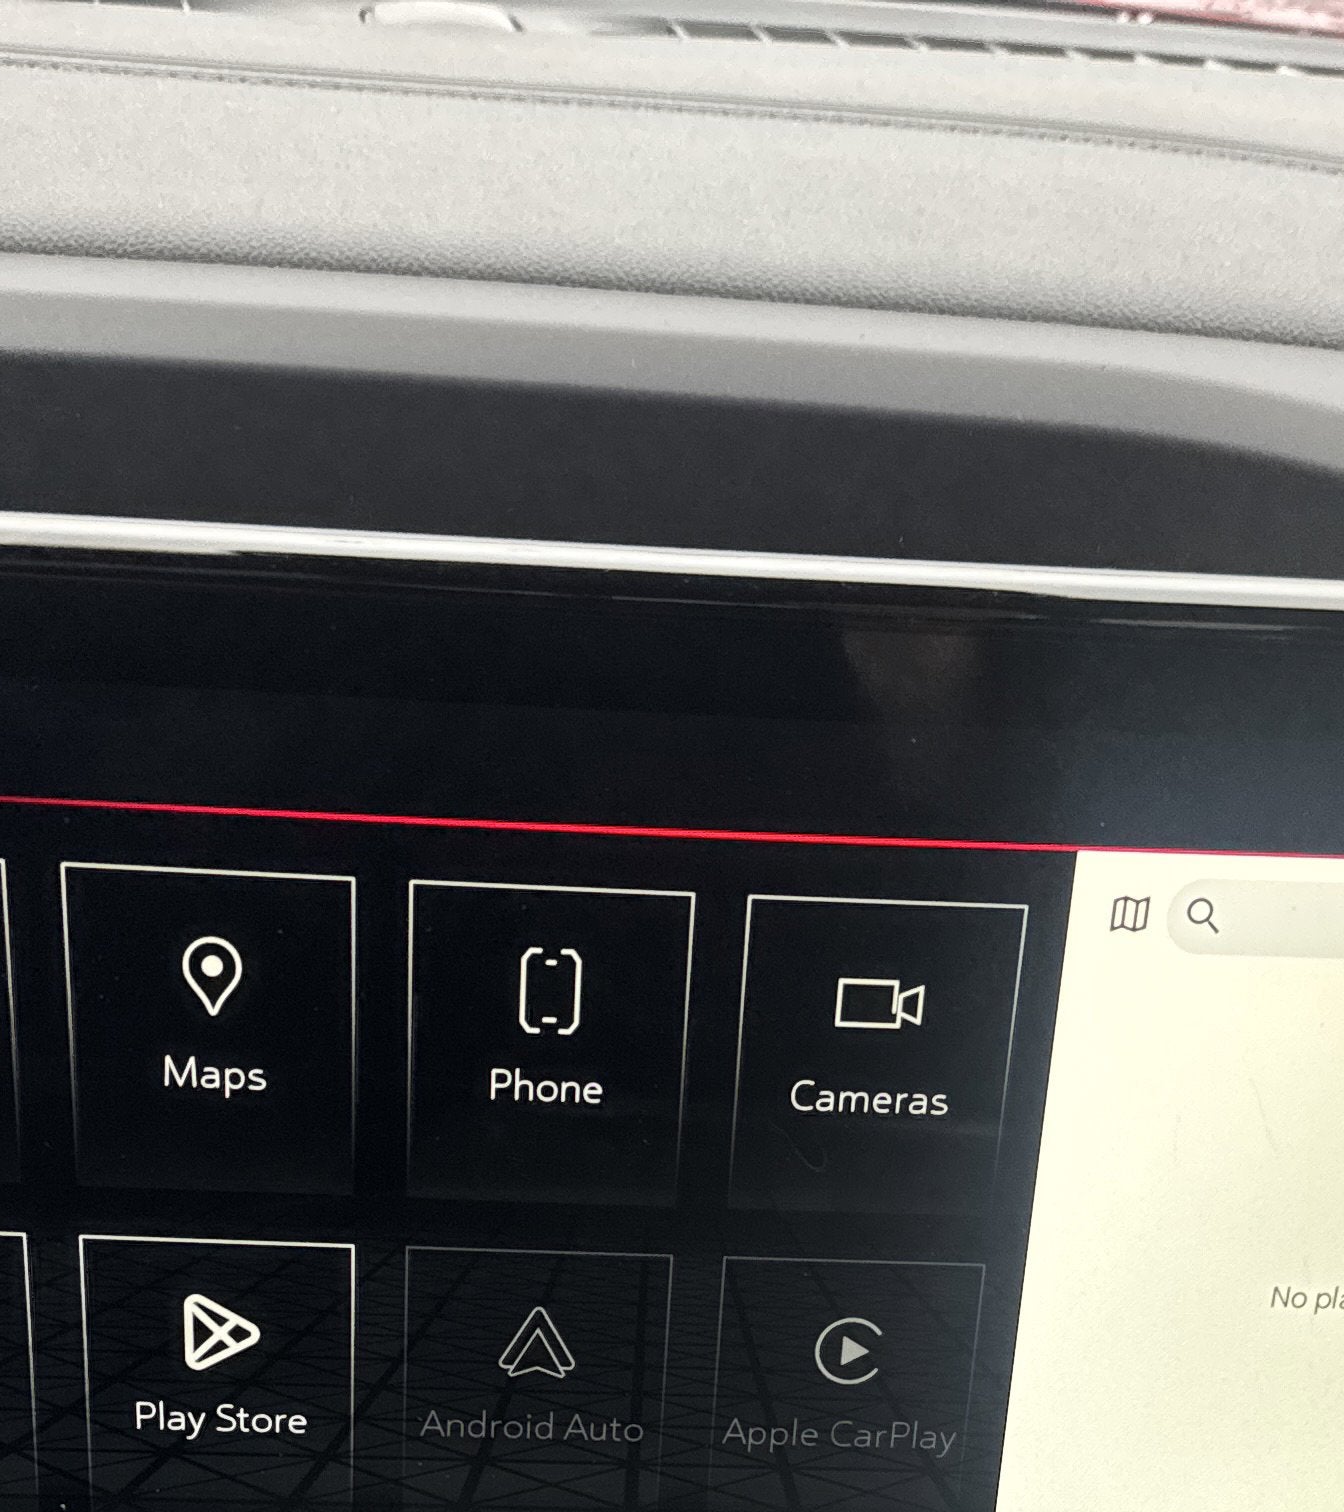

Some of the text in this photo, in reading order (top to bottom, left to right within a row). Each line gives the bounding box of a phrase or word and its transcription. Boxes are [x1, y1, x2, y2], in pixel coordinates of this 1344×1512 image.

[162, 1055, 267, 1097] Maps
[489, 1068, 603, 1106] Phone
[789, 1080, 949, 1117] Cameras
[1270, 1286, 1308, 1312] No
[135, 1400, 308, 1440] Play Store
[420, 1409, 644, 1443] Android Auto
[722, 1416, 956, 1458] Apple CarPlay
